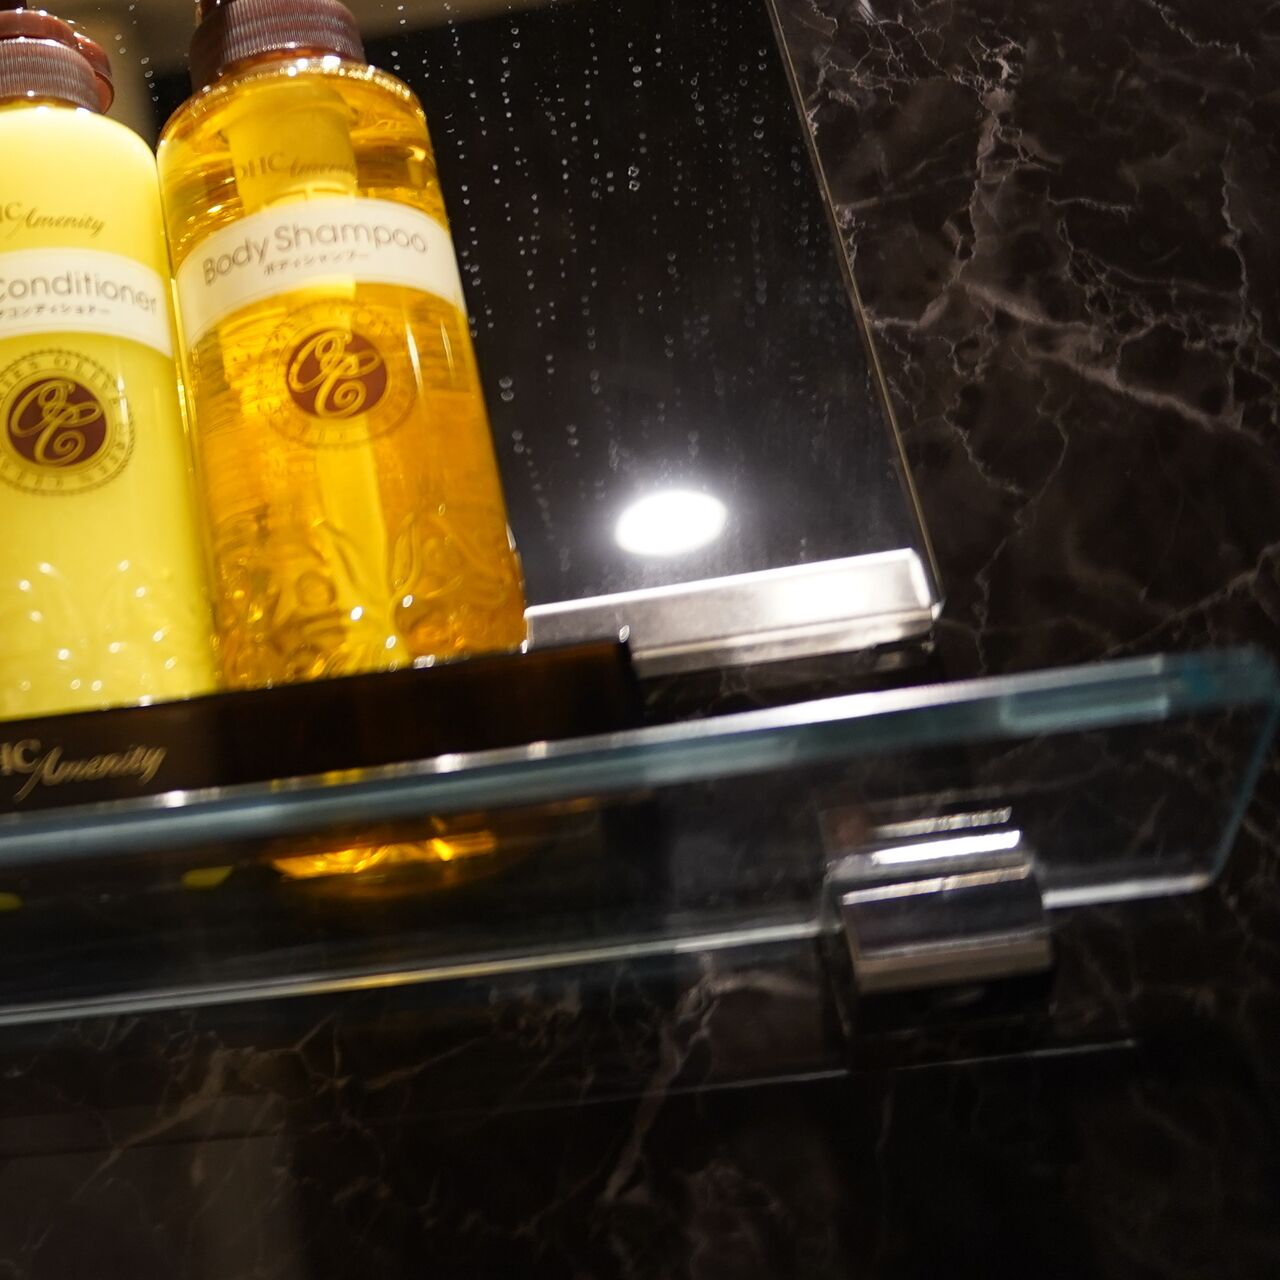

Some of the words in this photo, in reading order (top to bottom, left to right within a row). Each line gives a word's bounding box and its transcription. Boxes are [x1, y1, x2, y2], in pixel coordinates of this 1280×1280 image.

[7, 208, 105, 240] Amenity
[203, 238, 269, 286] Body
[274, 223, 428, 253] Shampoo
[12, 744, 168, 803] Amenity
